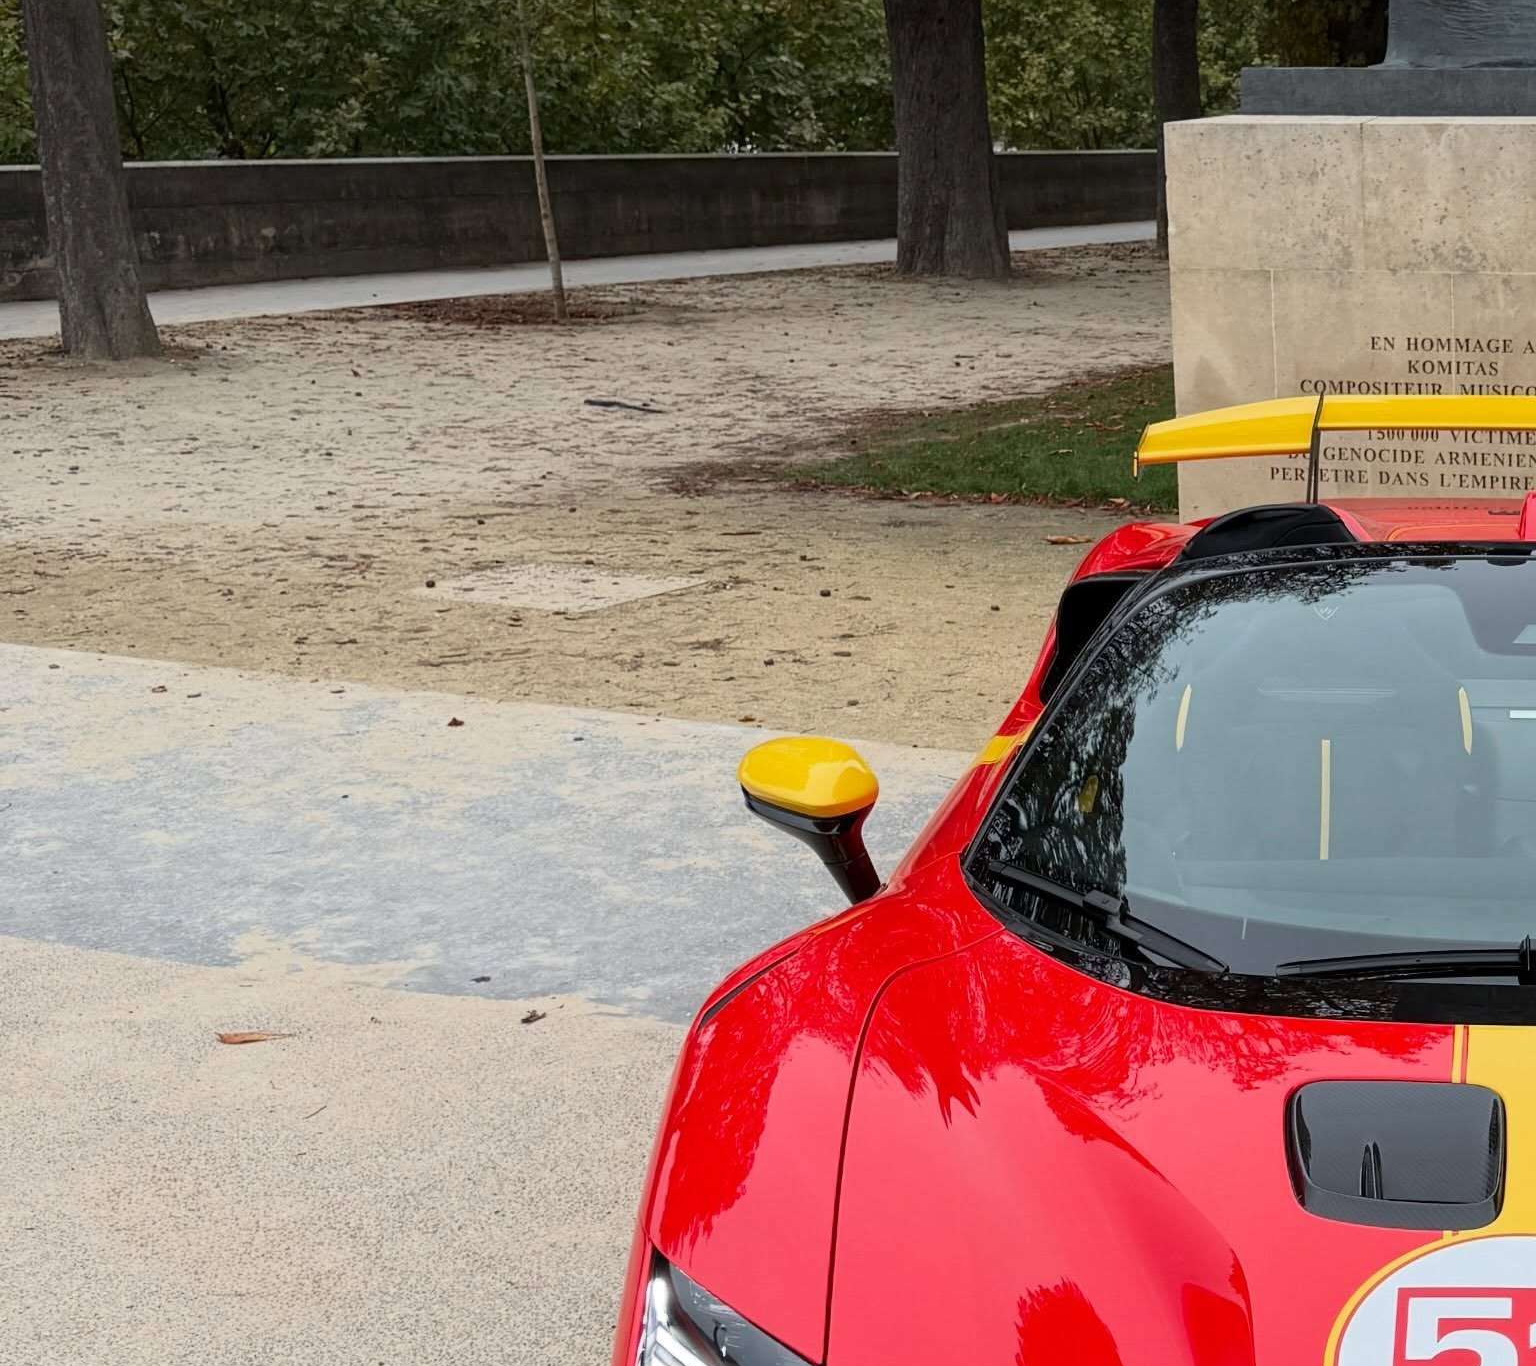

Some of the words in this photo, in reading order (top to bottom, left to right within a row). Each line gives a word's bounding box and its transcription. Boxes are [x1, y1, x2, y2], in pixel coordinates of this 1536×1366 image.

[1370, 336, 1396, 351] EN
[1406, 337, 1514, 354] HOMMAGE
[1522, 339, 1536, 354] A
[1407, 360, 1500, 376] KOMITAS
[1300, 379, 1443, 396] COMPOSITEUR
[1323, 446, 1425, 464] GENOCIDE
[1270, 466, 1369, 484] PERETRE
[1378, 470, 1430, 487] DANS
[1440, 473, 1534, 491] L'EMPIRE
